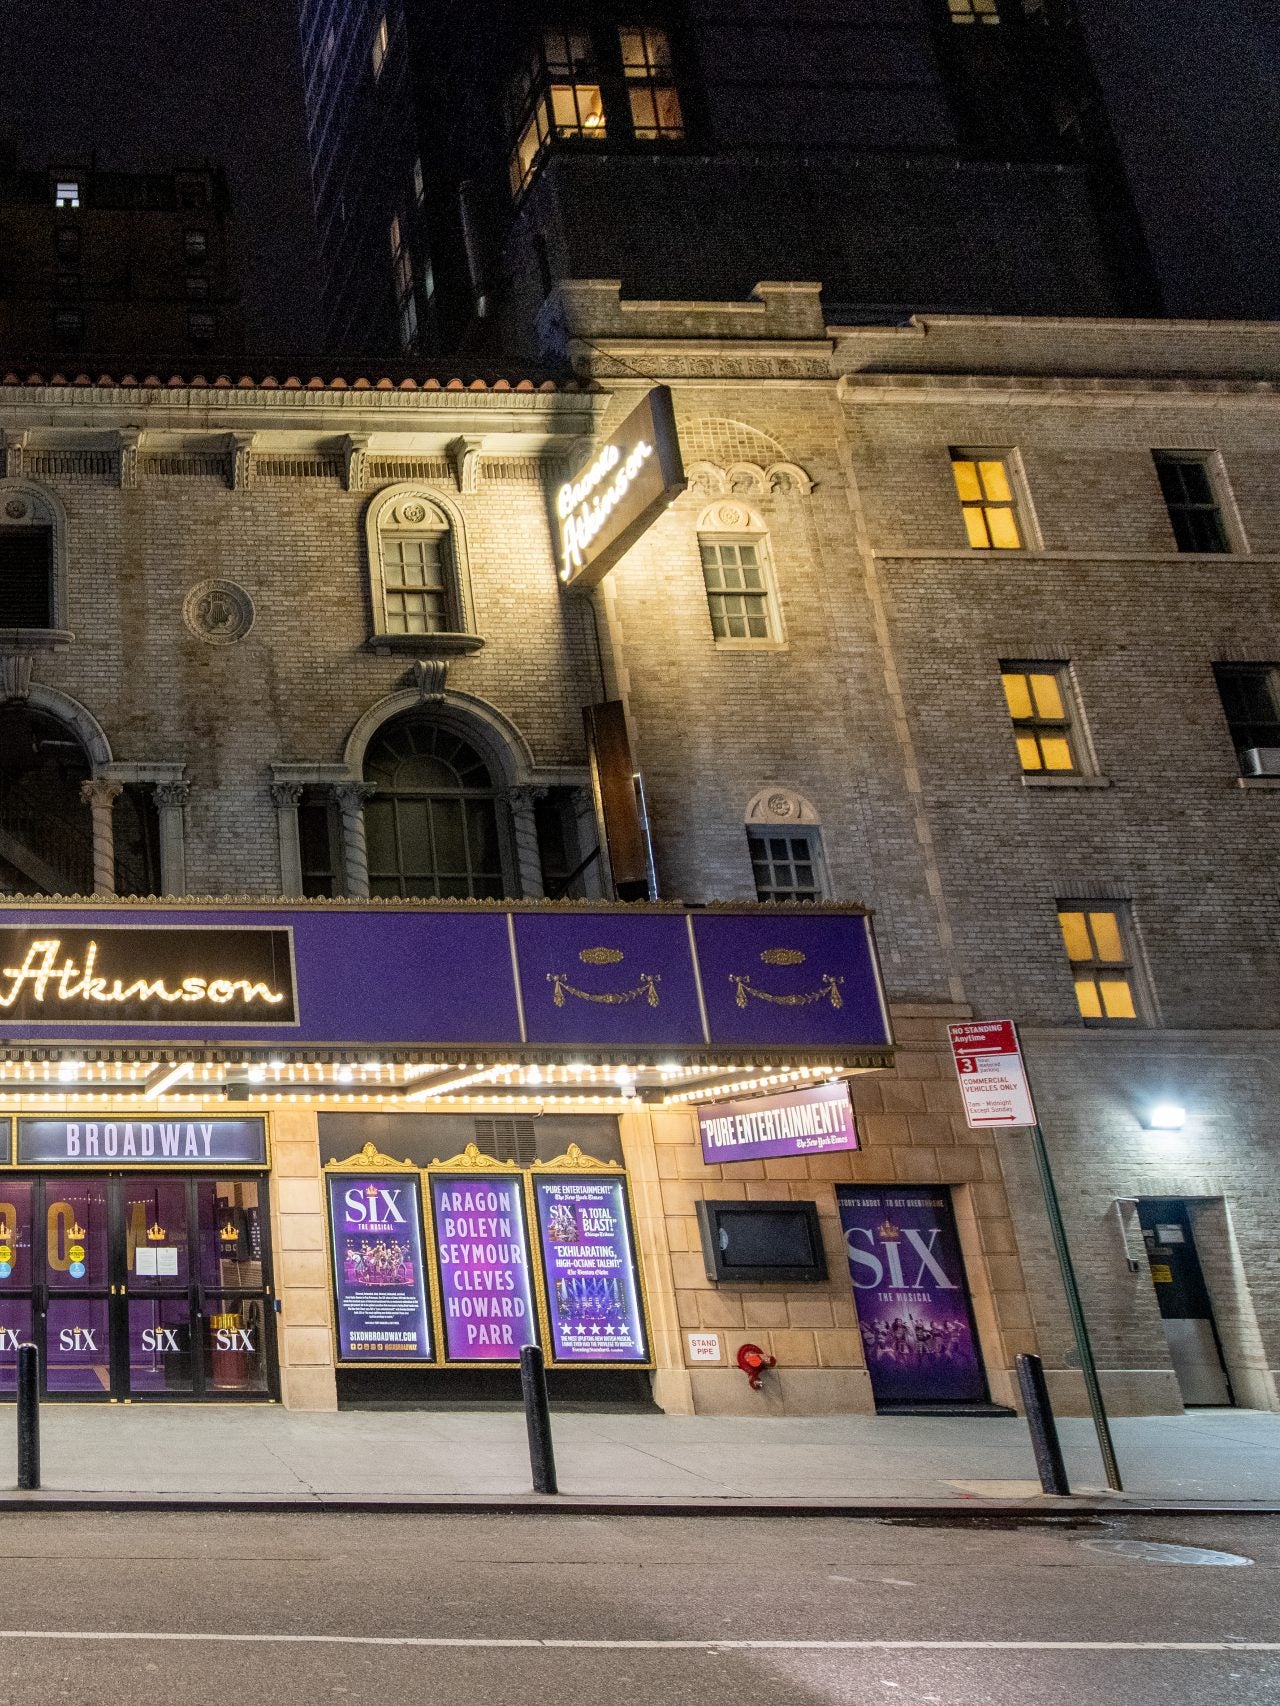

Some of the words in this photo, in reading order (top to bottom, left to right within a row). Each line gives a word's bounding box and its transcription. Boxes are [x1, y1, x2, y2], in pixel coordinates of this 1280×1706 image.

[558, 445, 618, 519] Brooks
[560, 441, 652, 581] Atkinson
[951, 1027, 963, 1035] NO
[964, 1024, 1002, 1034] STANDING
[955, 1034, 986, 1043] Anytime
[961, 1058, 973, 1073] 3
[963, 1077, 1009, 1086] COMMERCIAL
[965, 1084, 999, 1093] VEHICLES
[1000, 1083, 1018, 1091] ONLY
[701, 1116, 737, 1148] "PURE
[735, 1100, 849, 1144] ENTERTAINMENT!"
[67, 1124, 214, 1156] BROADWAY
[562, 1185, 613, 1194] ENTERTAINMENT!"
[345, 1188, 408, 1223] SIX
[441, 1192, 511, 1212] ARAGON
[588, 1207, 612, 1219] TOTAL
[445, 1218, 512, 1238] BOLEYN
[582, 1218, 617, 1232] BLAST!"
[440, 1244, 523, 1264] SEYMOUR
[554, 1245, 618, 1259] "EXHILARATING,
[843, 1227, 960, 1290] SIX
[555, 1259, 596, 1268] HIGH-OCTANE
[454, 1270, 515, 1291] CLEVES
[878, 1292, 893, 1302] THE
[896, 1292, 932, 1302] MUSICAL
[448, 1297, 525, 1318] HOWARD
[60, 1329, 99, 1352] SIX
[141, 1329, 181, 1352] SIX
[350, 1331, 417, 1342] SIXONBROADWAY.COM
[467, 1324, 514, 1345] PARR
[691, 1339, 717, 1347] STAND
